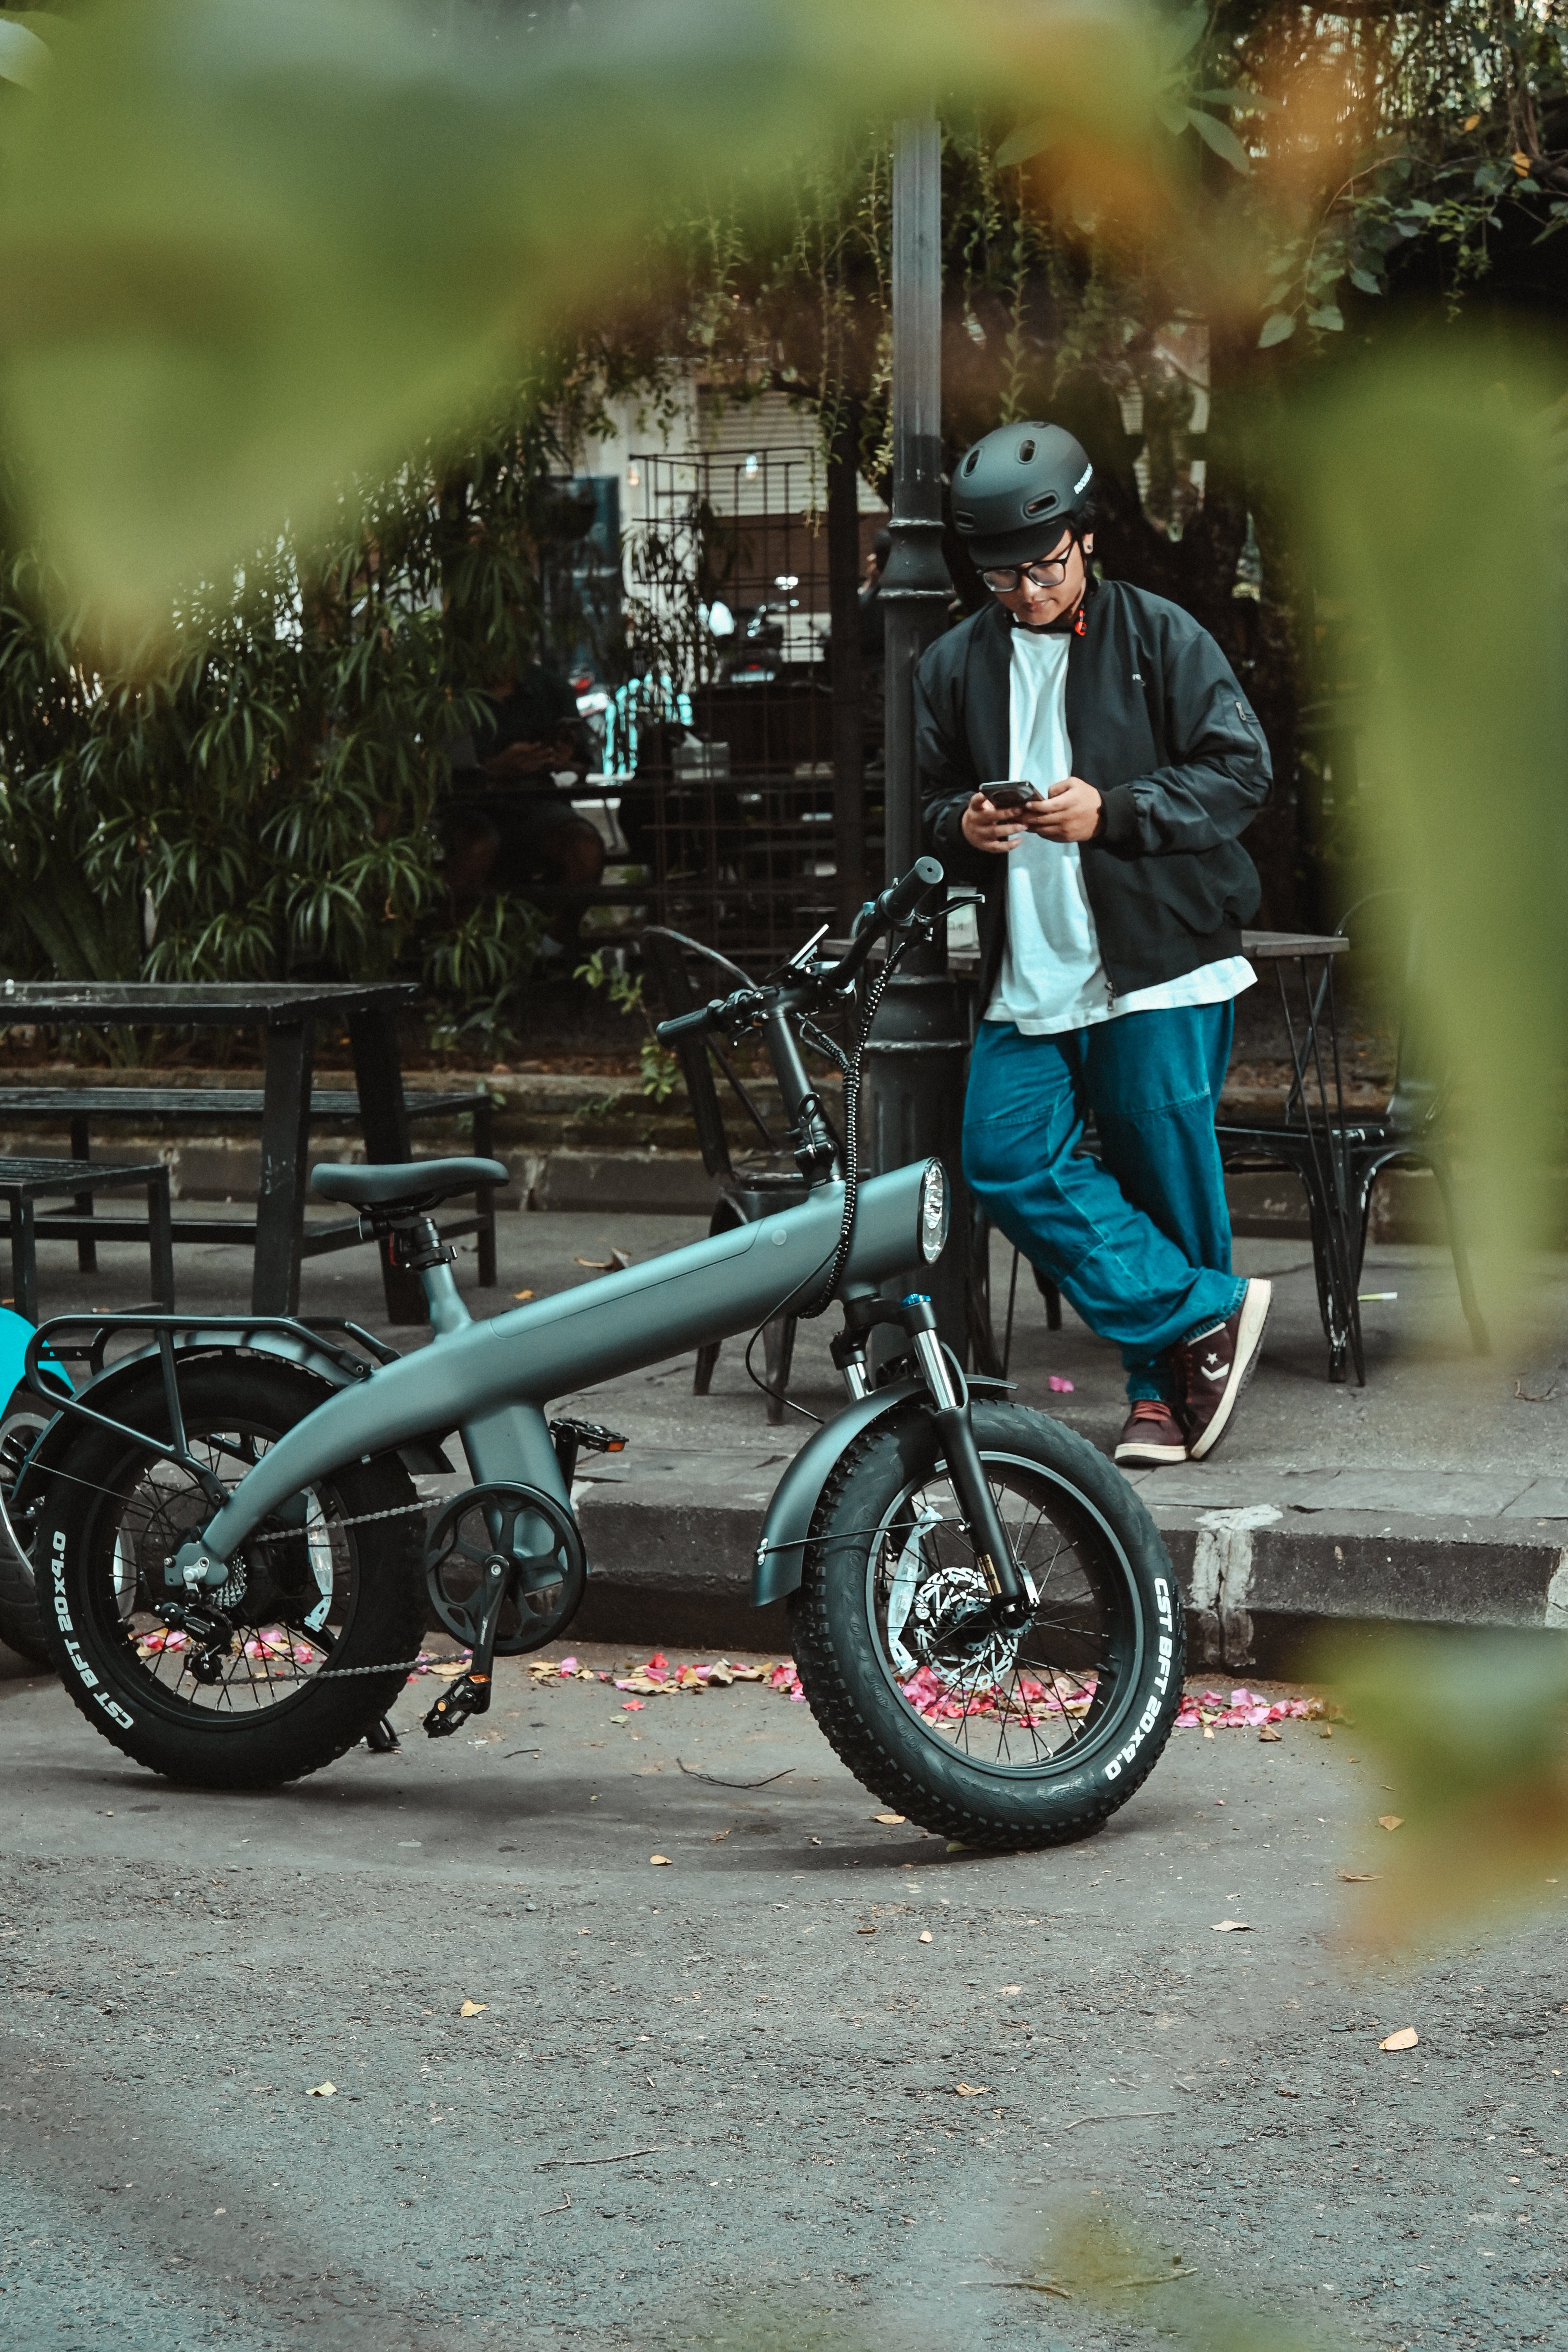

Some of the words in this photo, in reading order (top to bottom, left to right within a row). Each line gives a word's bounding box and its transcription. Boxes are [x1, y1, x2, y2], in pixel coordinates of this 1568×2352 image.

[1154, 1578, 1172, 1632] CST
[64, 1639, 99, 1688] BFT
[1154, 1636, 1172, 1695] BFT
[93, 1692, 134, 1729] CST
